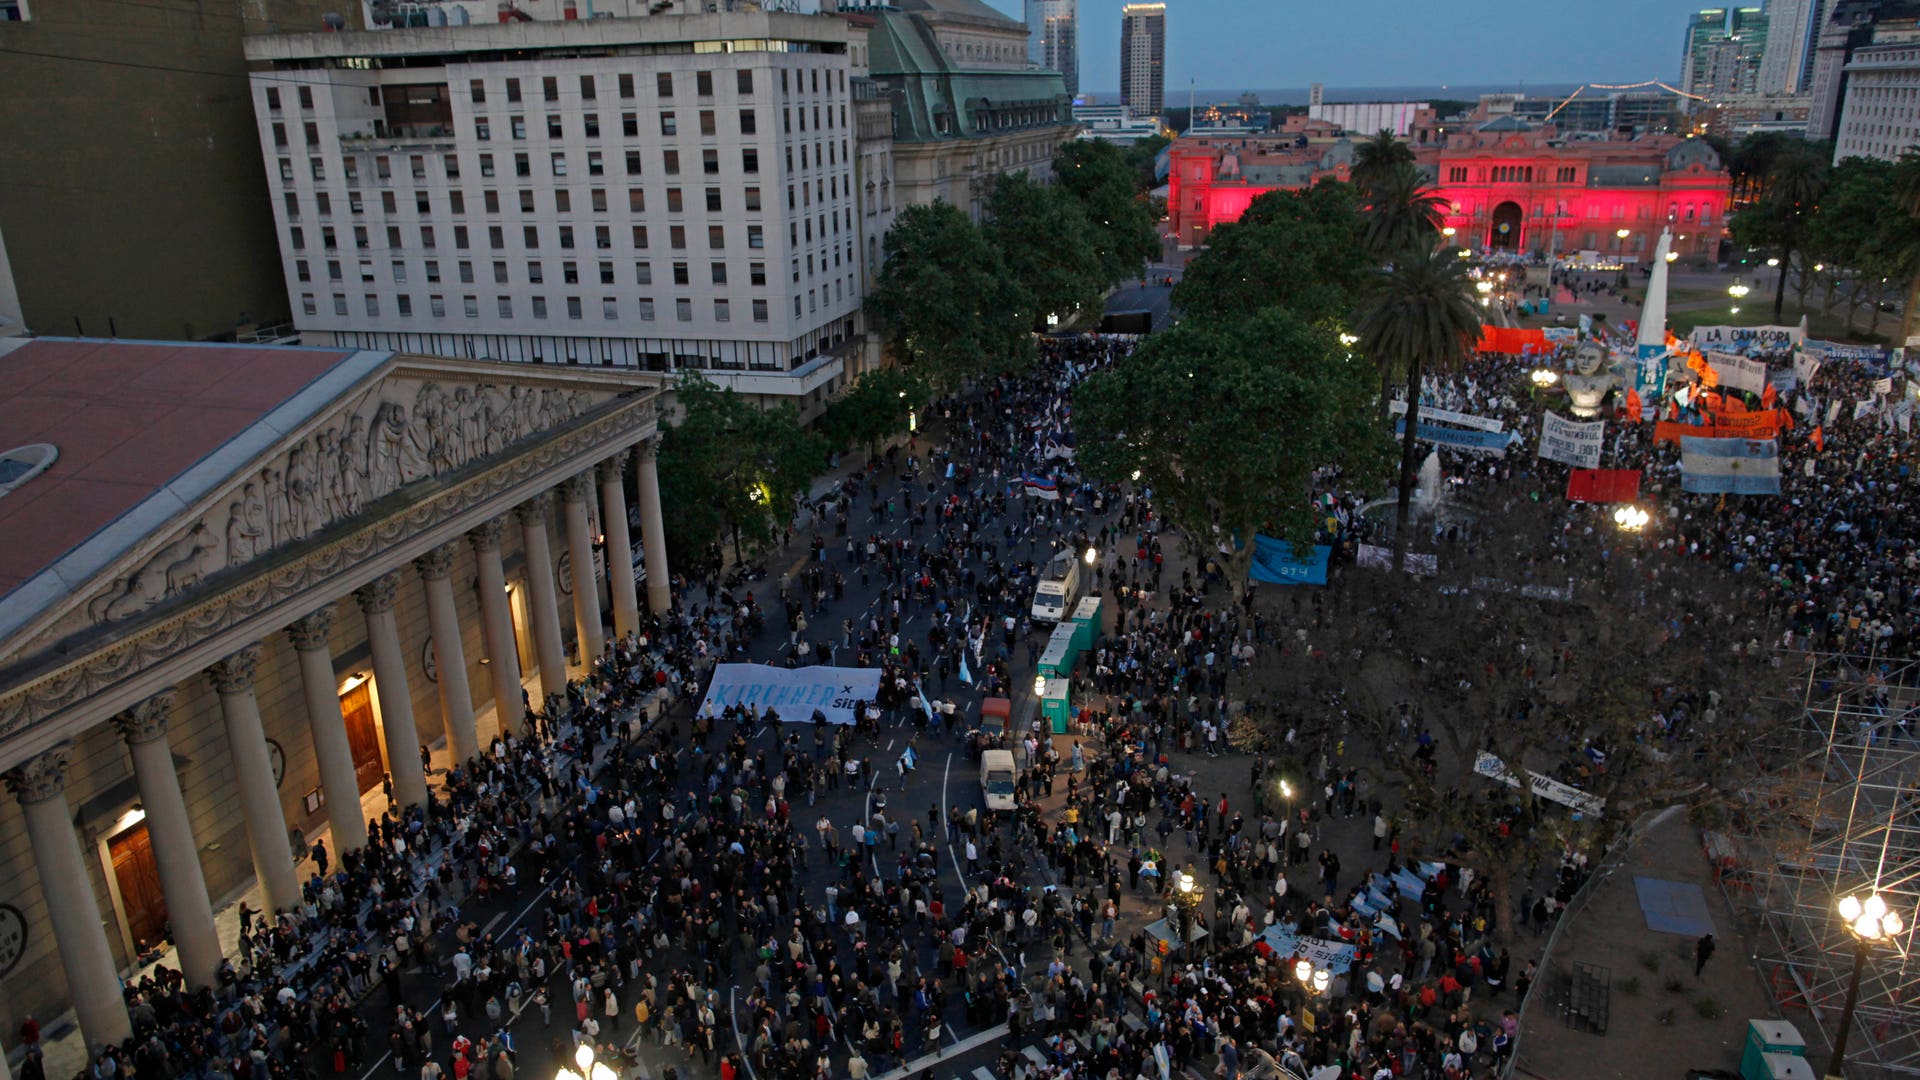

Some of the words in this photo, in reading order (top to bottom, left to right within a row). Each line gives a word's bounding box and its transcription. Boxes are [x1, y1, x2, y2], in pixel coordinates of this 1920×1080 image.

[1707, 329, 1721, 342] LA
[1280, 566, 1308, 577] 914
[715, 684, 836, 705] KIRCHNER
